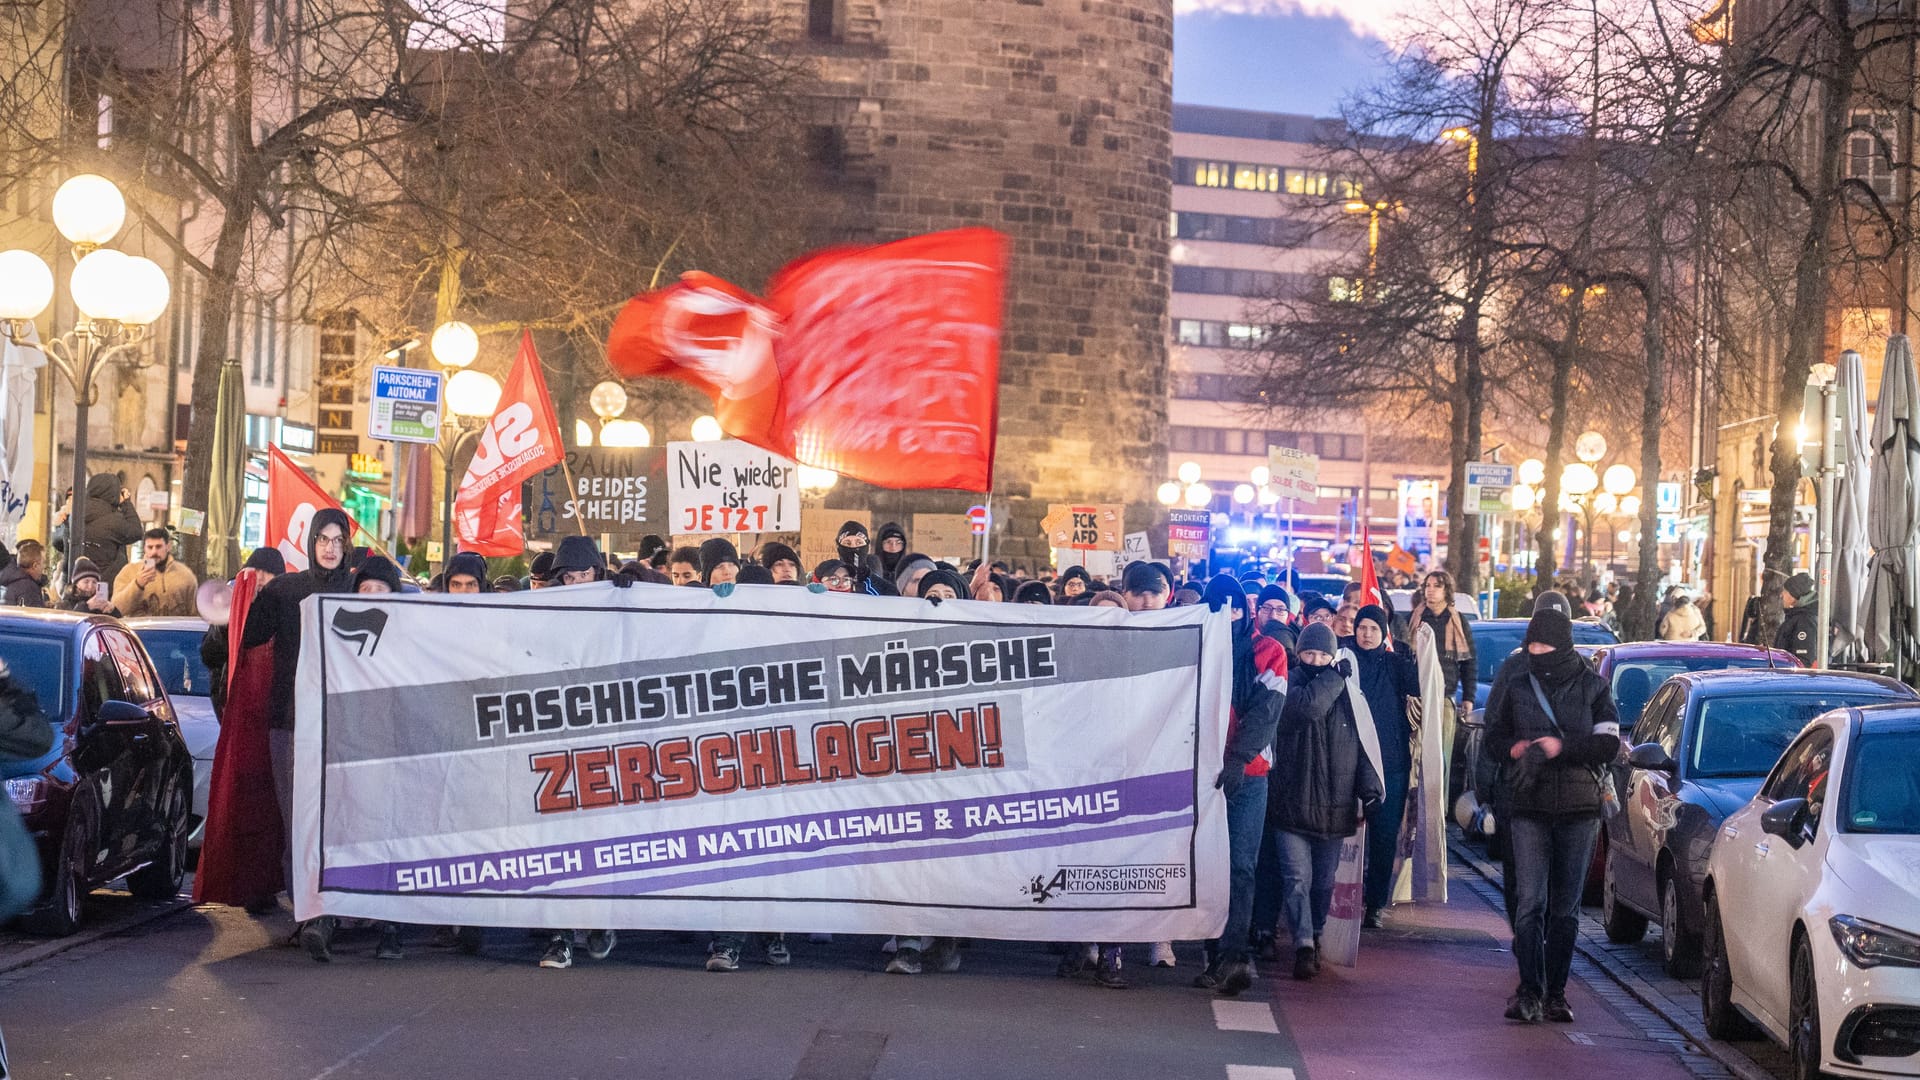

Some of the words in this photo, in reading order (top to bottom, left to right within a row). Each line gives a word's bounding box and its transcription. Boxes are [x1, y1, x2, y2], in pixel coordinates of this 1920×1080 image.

[379, 372, 437, 388] PARKSCHEIN-
[387, 385, 427, 399] AUTOMAT
[678, 449, 722, 490] Nie
[733, 456, 793, 490] wieder
[1477, 475, 1504, 485] AUTOMAT
[578, 476, 648, 499] BEIDES
[722, 486, 748, 509] ist
[1073, 513, 1097, 529] FCK
[1073, 530, 1097, 545] AFD
[474, 659, 826, 740] FASCHISTISCHE
[838, 633, 1057, 700] MÄRSCHE
[530, 702, 1004, 815] ZERSCHLAGEN!
[396, 850, 582, 891] SOLIDARISCH
[595, 836, 687, 869] GEGEN
[698, 811, 923, 856] NATIONALISMUS
[934, 809, 954, 831] &
[965, 790, 1120, 828] RASSISMUS
[1047, 867, 1187, 891] ANTIFASCHISTISCHES
